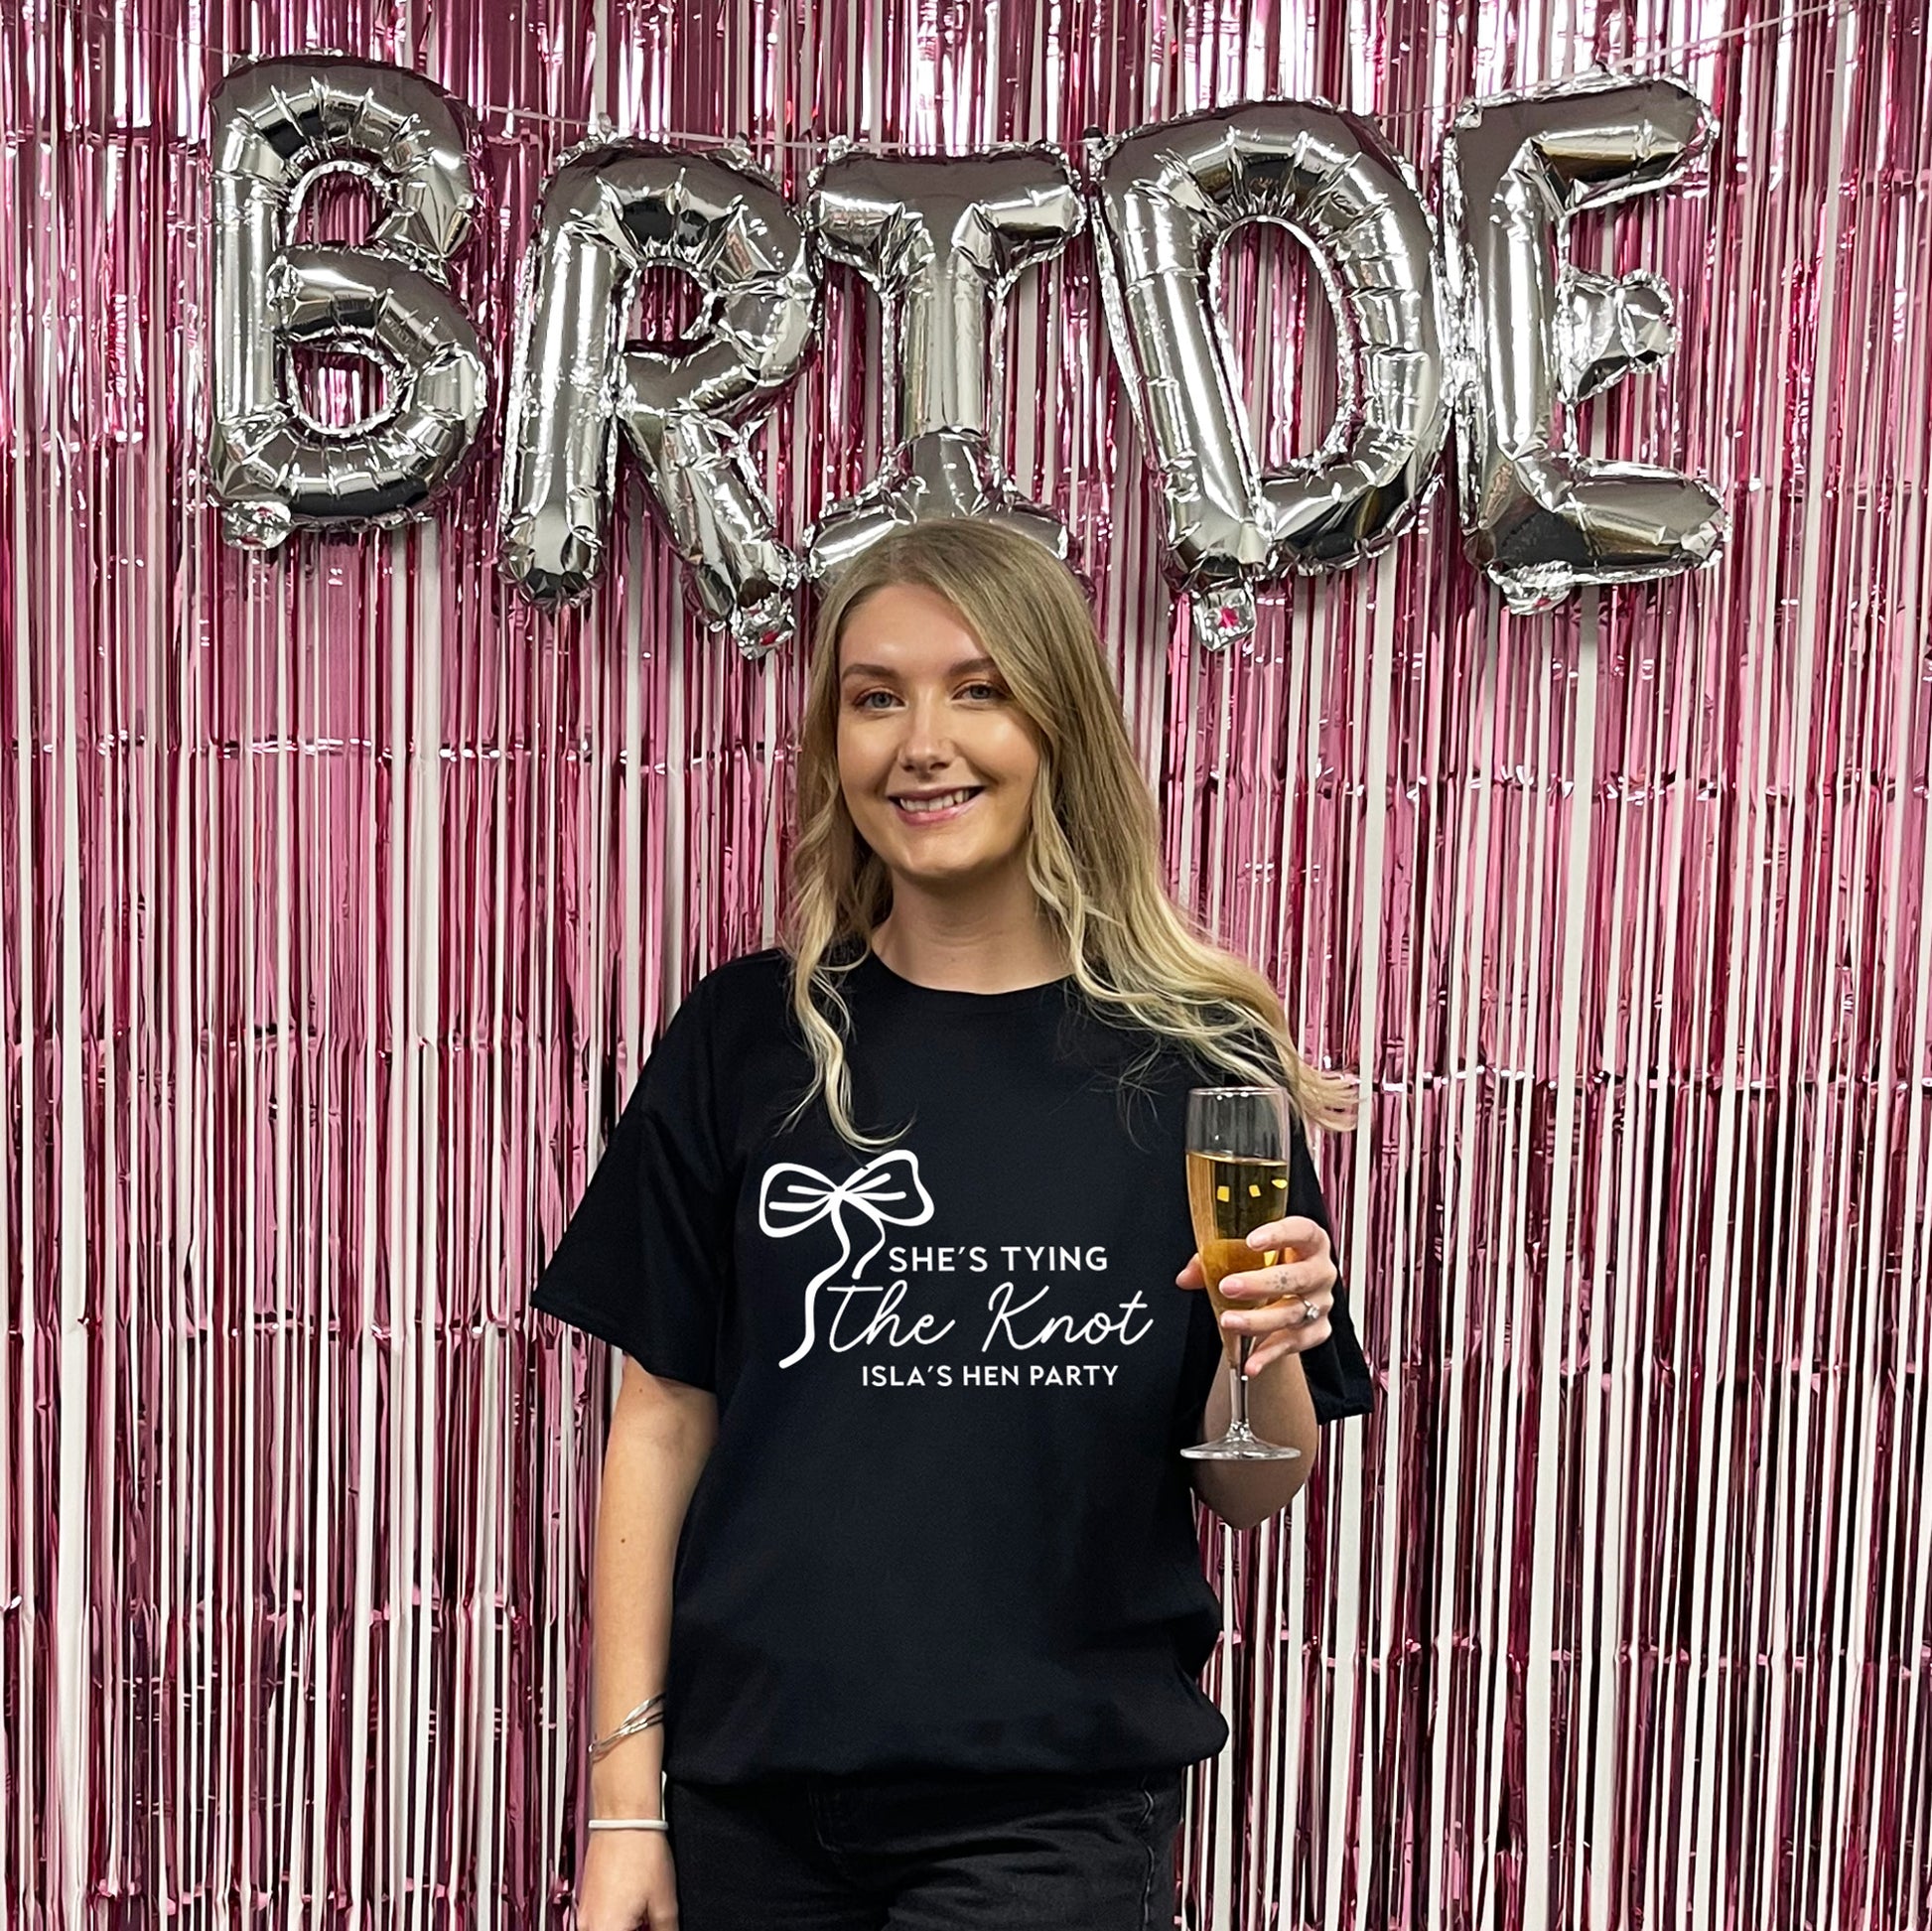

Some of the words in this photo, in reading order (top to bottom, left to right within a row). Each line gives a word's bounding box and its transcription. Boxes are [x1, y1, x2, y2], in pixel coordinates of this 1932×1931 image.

[206, 48, 1727, 655] BRIDE
[1000, 1246, 1109, 1273] TYING
[981, 1282, 1155, 1353] Knot
[962, 1365, 1020, 1387] HEN
[1030, 1364, 1120, 1387] PARTY
